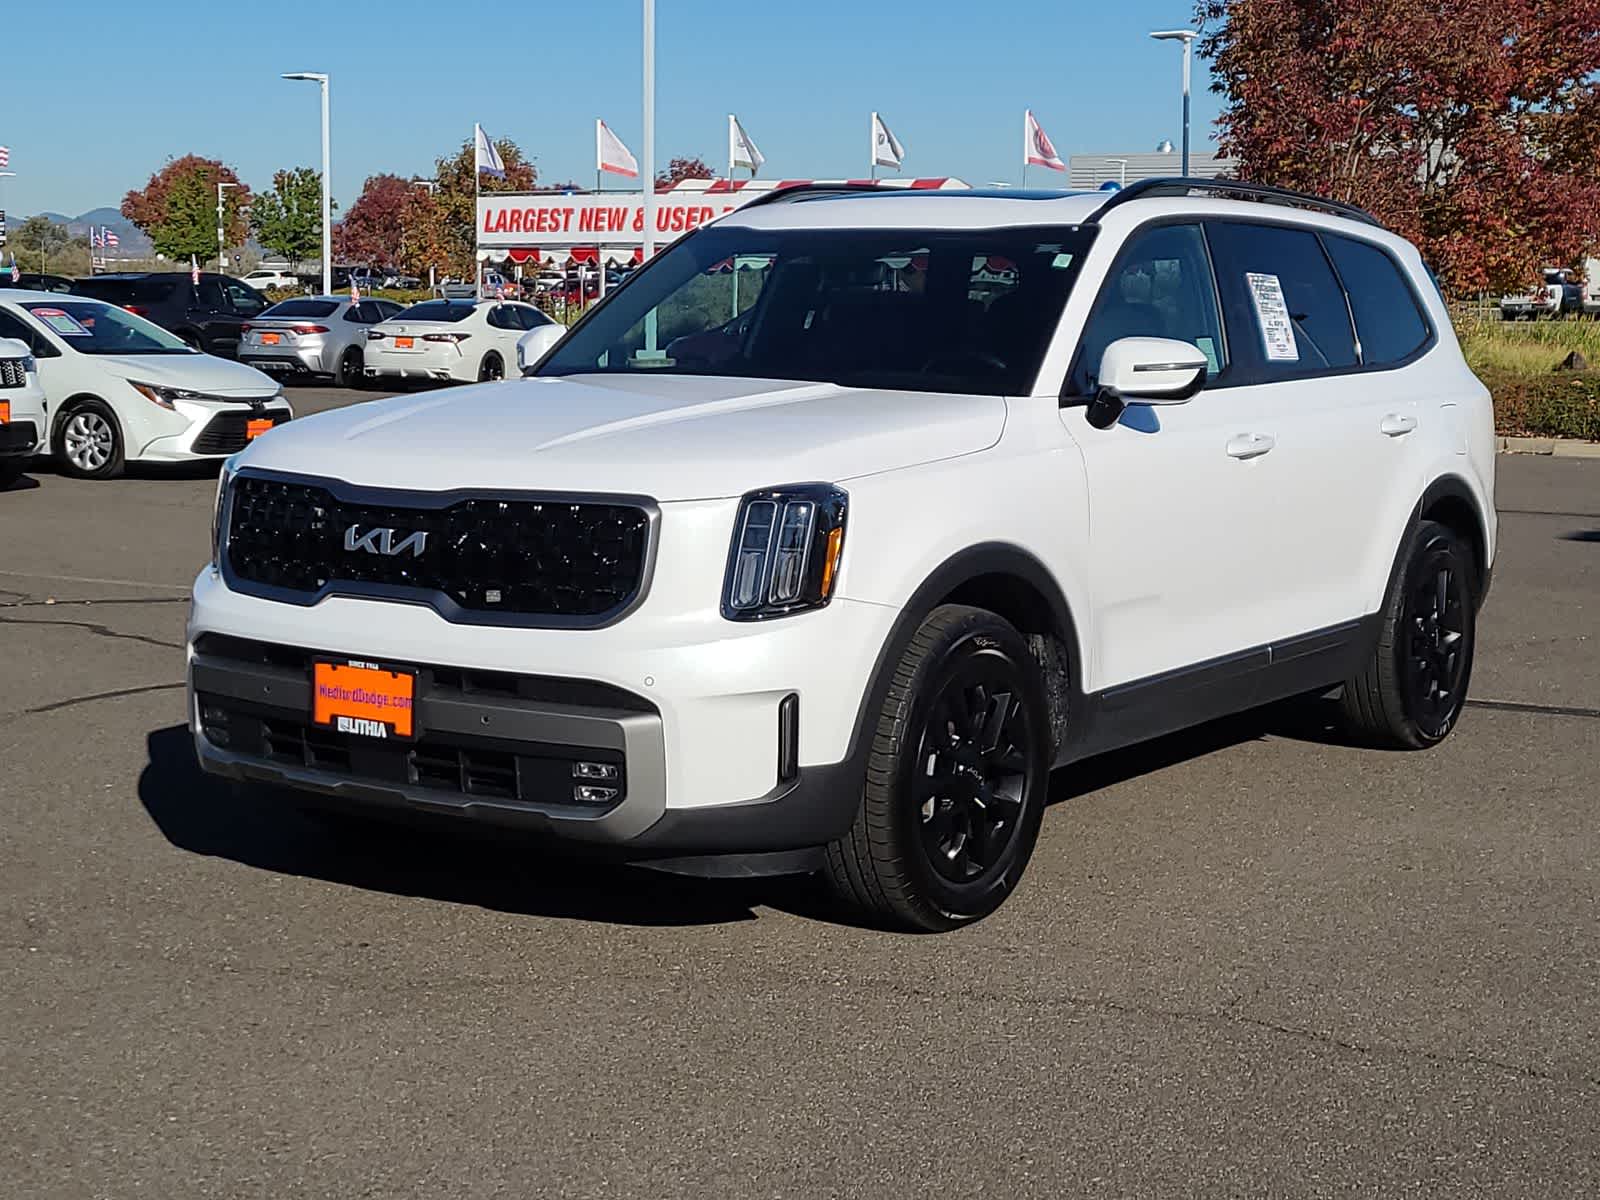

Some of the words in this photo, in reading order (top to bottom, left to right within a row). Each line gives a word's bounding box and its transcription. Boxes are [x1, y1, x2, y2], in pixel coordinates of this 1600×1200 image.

[484, 207, 574, 233] LARGEST
[579, 207, 628, 232] NEW
[632, 206, 645, 233] &
[655, 206, 715, 233] USED
[343, 523, 429, 558] KIA
[350, 718, 388, 739] LITHIA
